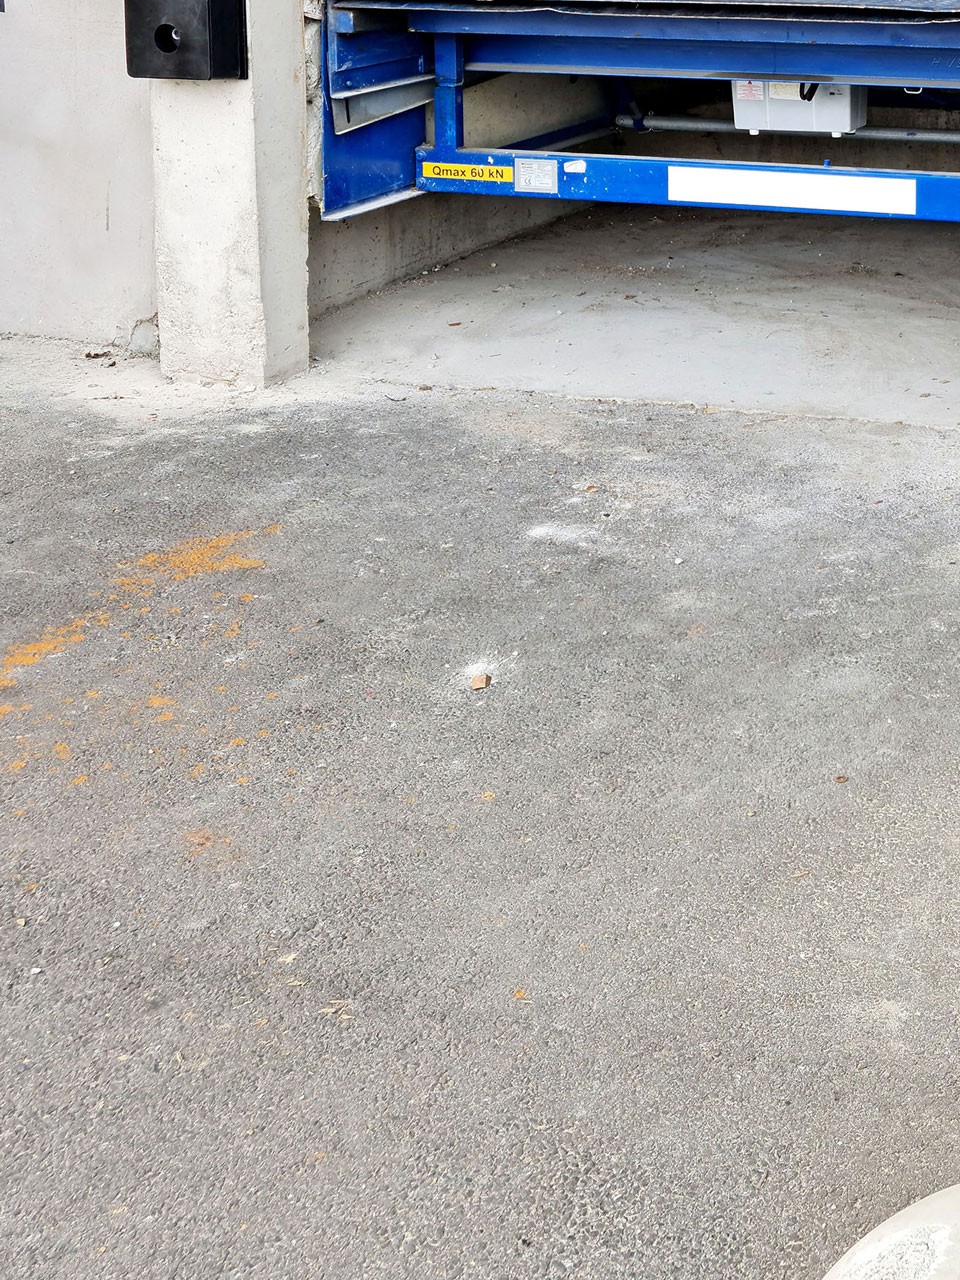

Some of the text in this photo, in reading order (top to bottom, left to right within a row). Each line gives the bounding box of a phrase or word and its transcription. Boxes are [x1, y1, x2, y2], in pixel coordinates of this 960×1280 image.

[432, 165, 504, 179] Qmax 60 kN
